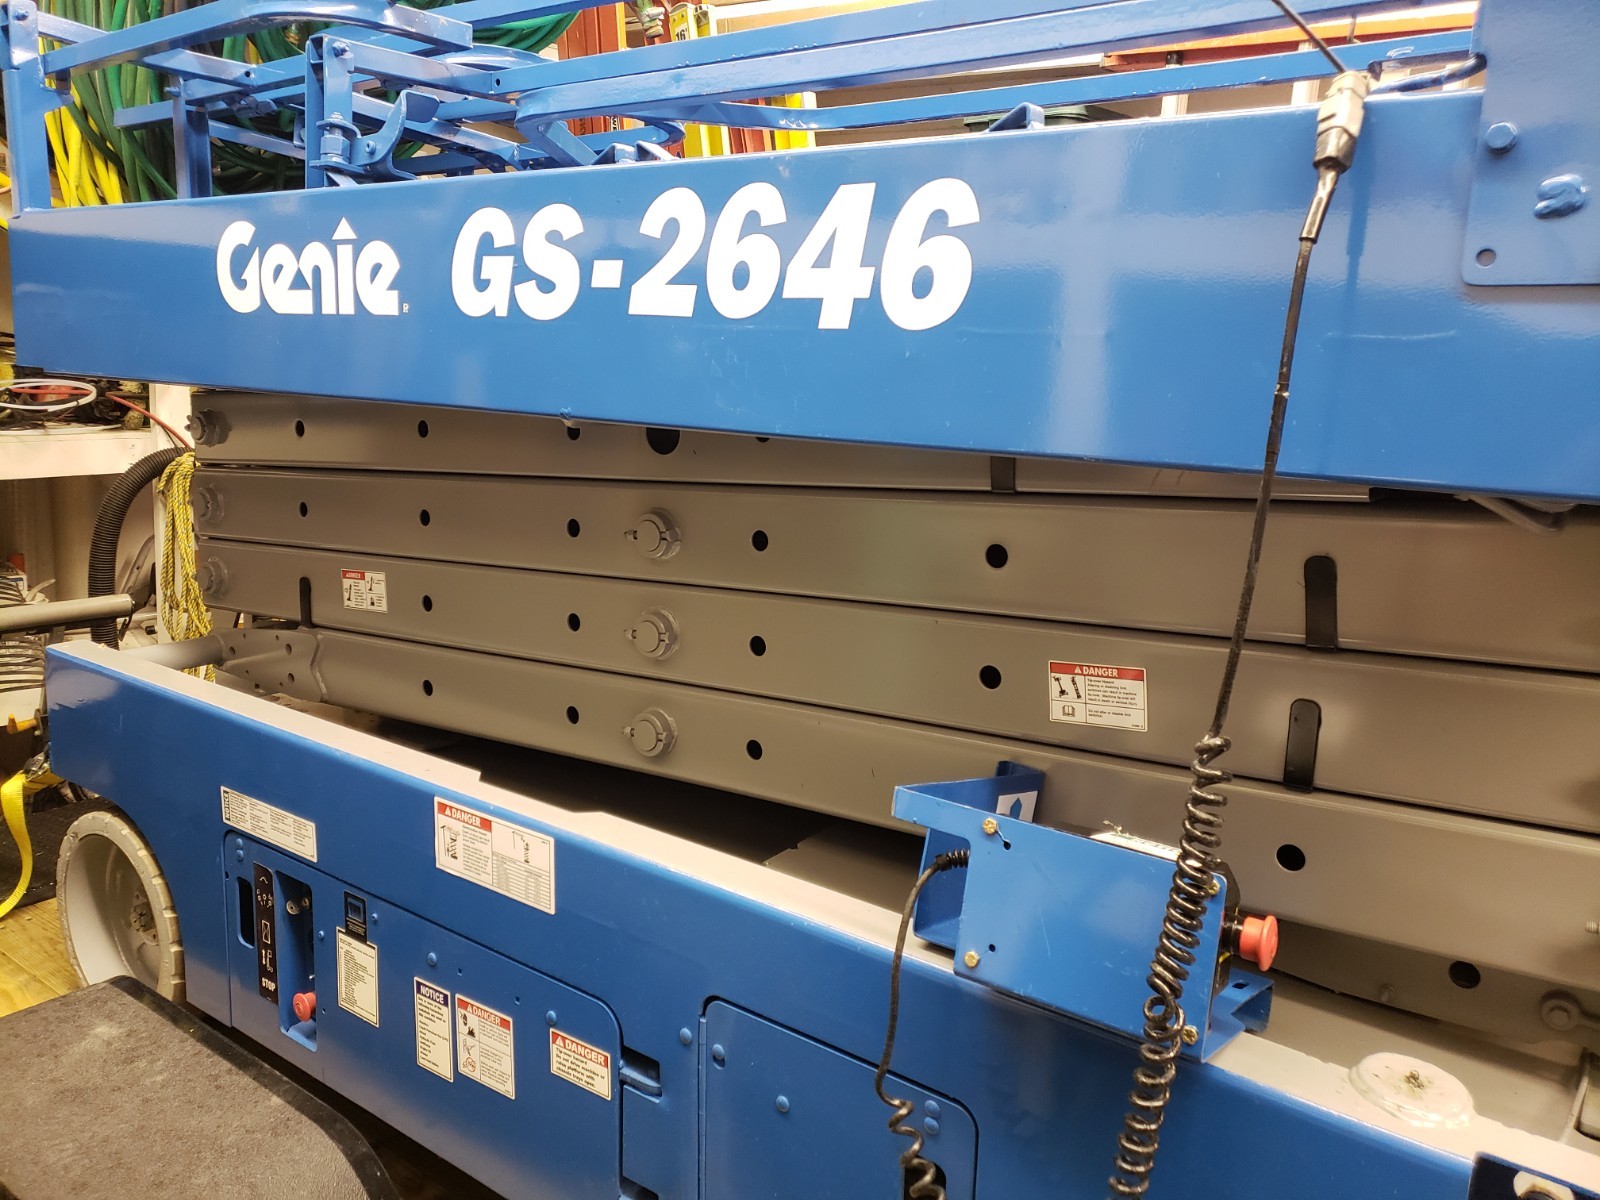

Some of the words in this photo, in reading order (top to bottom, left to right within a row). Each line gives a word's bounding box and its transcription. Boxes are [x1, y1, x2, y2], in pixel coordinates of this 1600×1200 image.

[216, 216, 400, 315] Genie
[451, 177, 980, 331] GS-2646
[1083, 666, 1118, 677] DANGER
[452, 807, 481, 828] DANGER
[262, 977, 276, 992] STOP
[420, 985, 445, 1004] NOTICE
[473, 1006, 500, 1026] DANGER
[565, 1039, 605, 1066] DANGER
